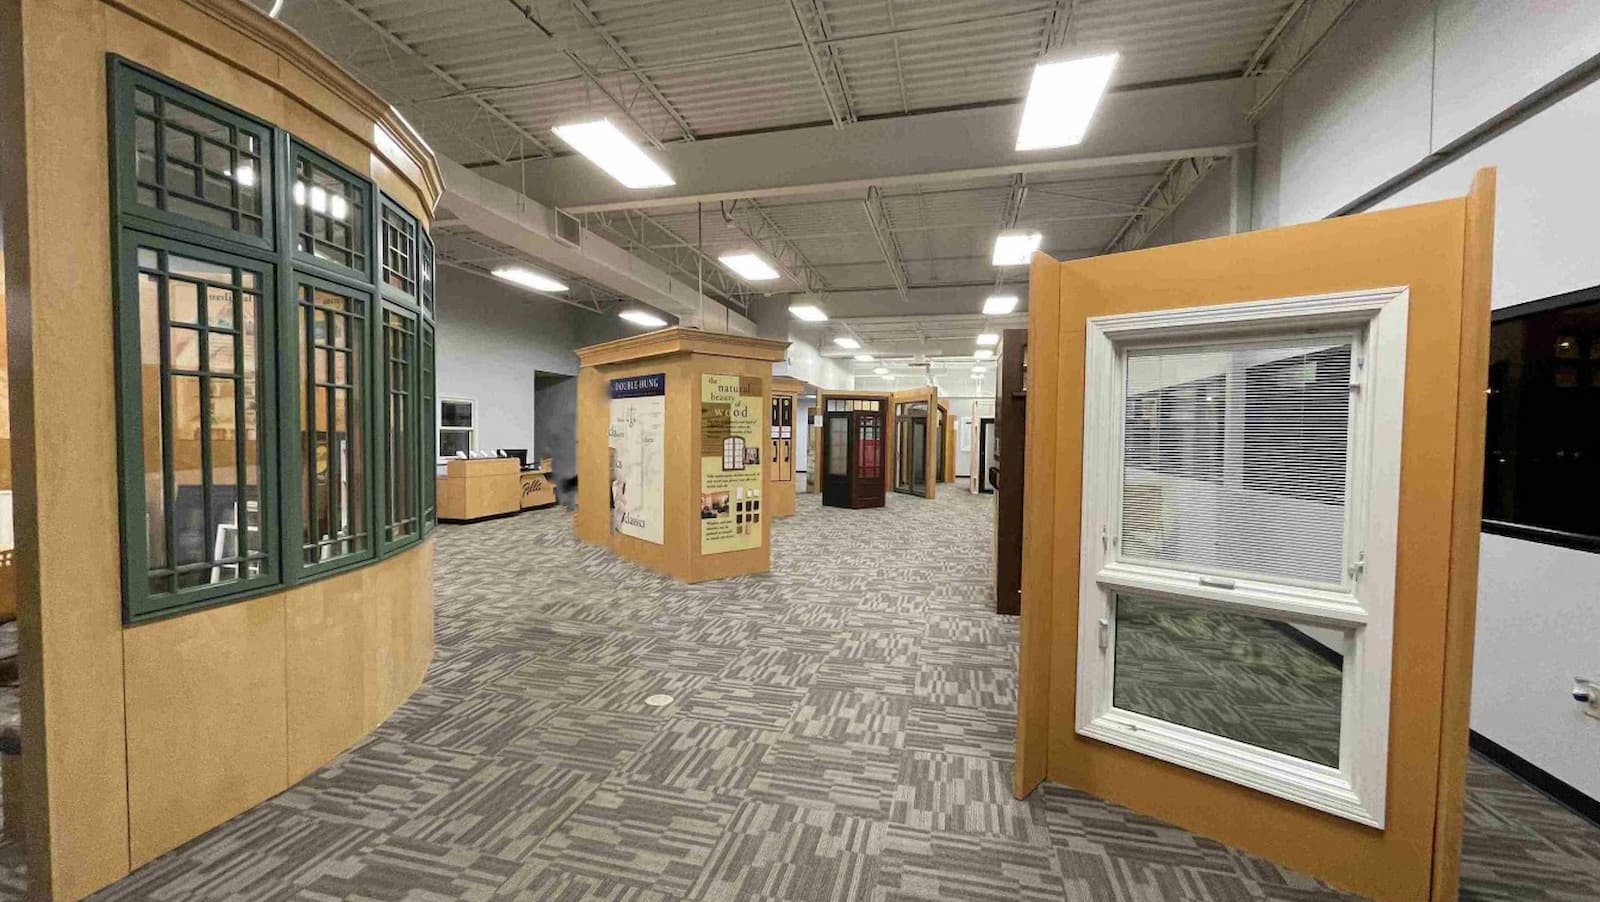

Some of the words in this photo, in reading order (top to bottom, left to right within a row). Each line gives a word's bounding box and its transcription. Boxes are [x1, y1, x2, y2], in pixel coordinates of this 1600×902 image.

[708, 376, 717, 385] the
[718, 384, 750, 393] natural
[711, 392, 735, 402] beauty
[715, 406, 748, 417] wood
[522, 480, 542, 496] Pella
